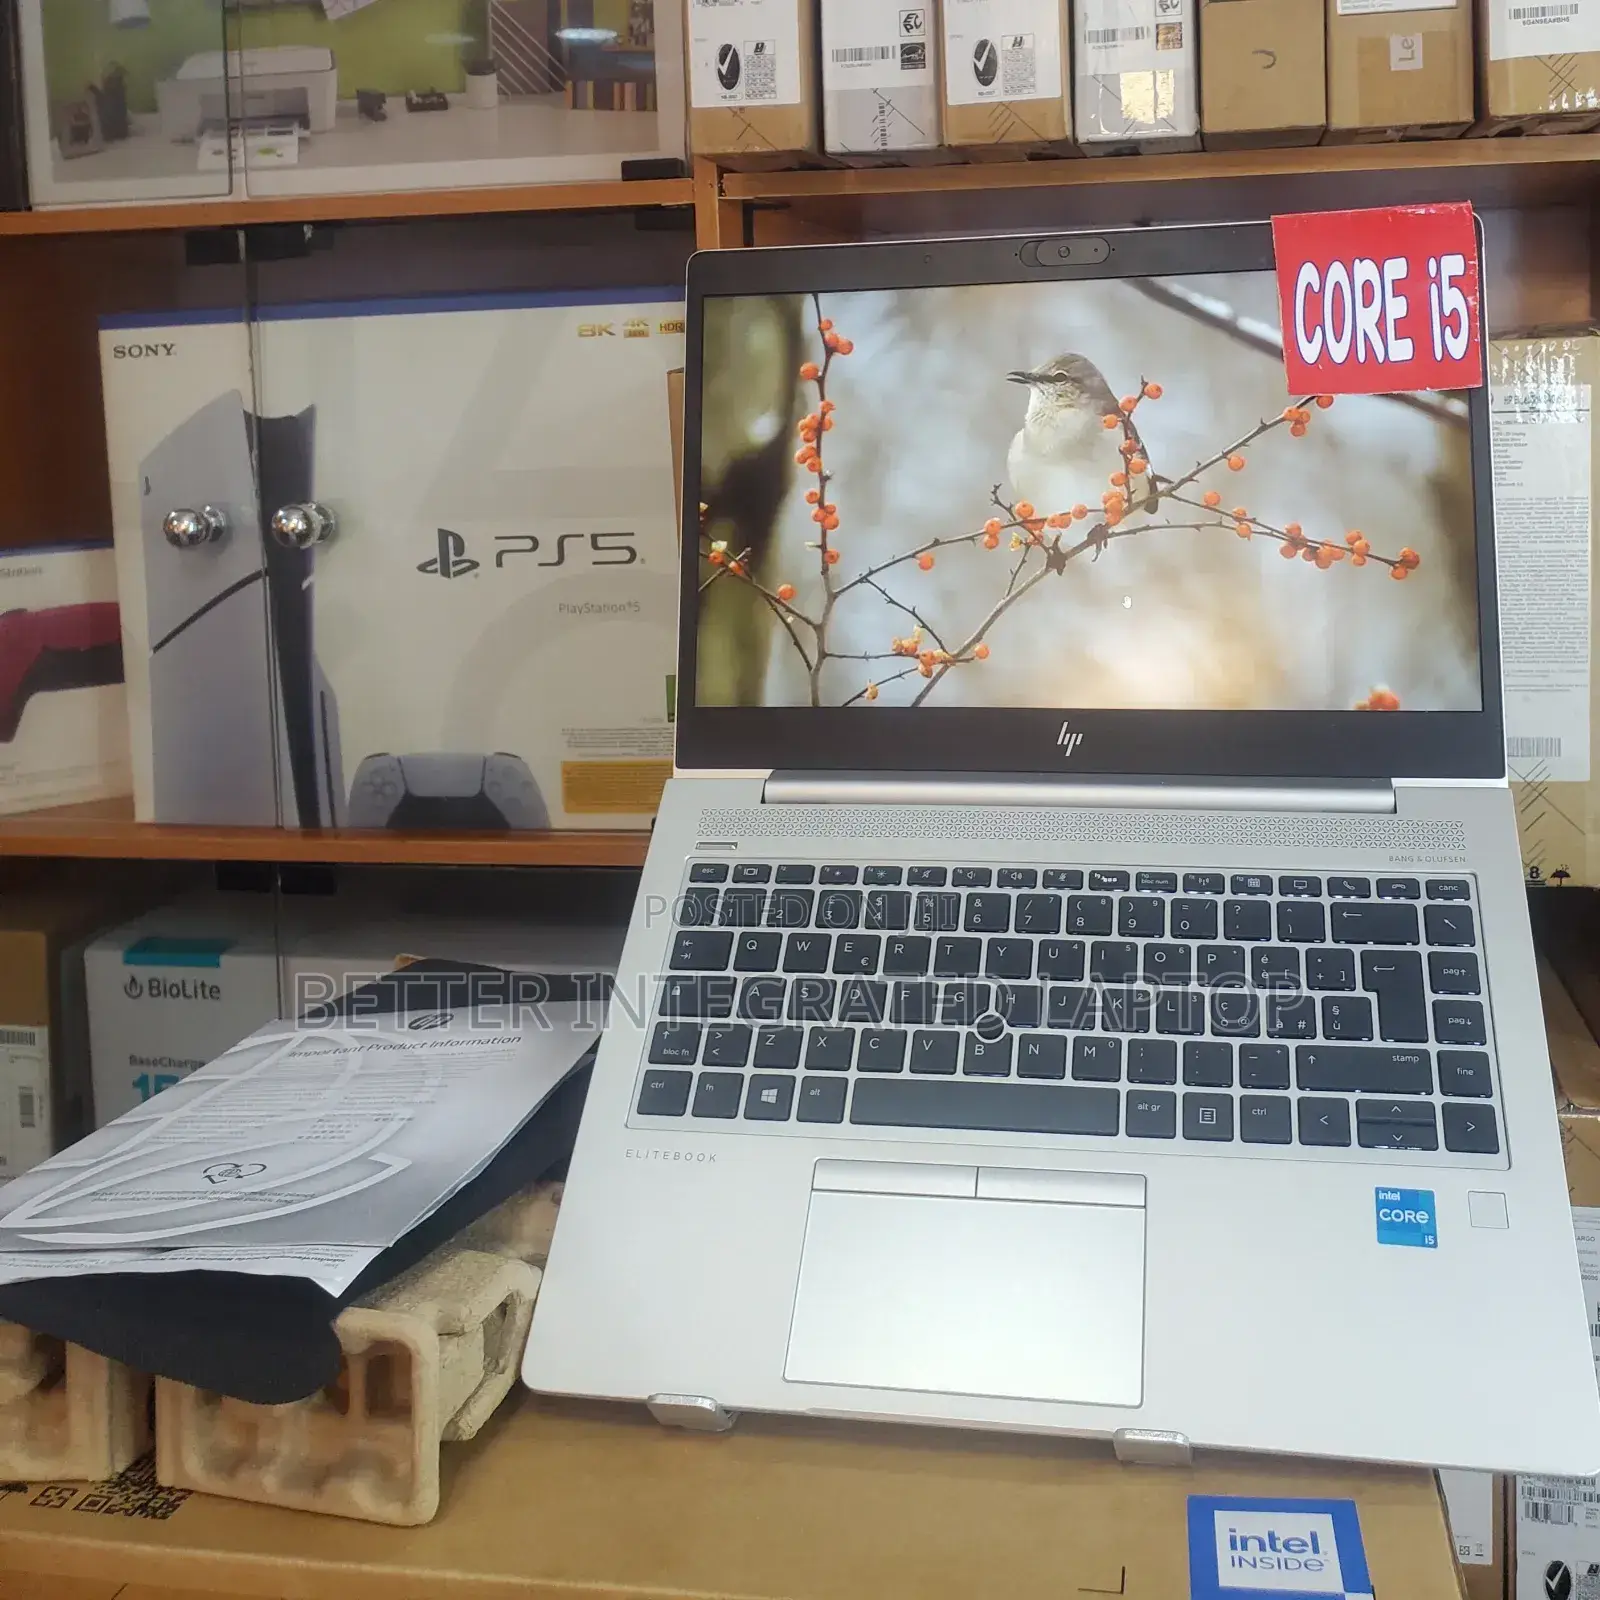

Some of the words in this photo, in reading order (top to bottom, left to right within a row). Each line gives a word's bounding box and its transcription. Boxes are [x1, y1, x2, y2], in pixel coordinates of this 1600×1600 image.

[1294, 257, 1415, 365] CORE
[1428, 254, 1470, 362] i5
[577, 323, 616, 337] 8K
[113, 343, 176, 359] SONY
[494, 532, 638, 568] PS5
[974, 898, 983, 908] &
[776, 910, 784, 919] 2
[1234, 904, 1241, 915] ?
[923, 913, 931, 923] 5
[973, 914, 982, 923] 6
[1024, 916, 1032, 925] 7
[1076, 917, 1085, 927] 8
[1128, 919, 1137, 928] 9
[746, 940, 758, 951] Q
[796, 941, 811, 951] W
[844, 942, 854, 953] E
[894, 944, 904, 954] R
[945, 945, 954, 955] T
[1179, 946, 1184, 954] 6
[997, 946, 1007, 957] Y
[1048, 948, 1059, 959] U
[860, 957, 870, 966] €
[1207, 954, 1217, 964] P
[1443, 967, 1460, 976] pag
[148, 976, 221, 1000] BioLite
[749, 985, 760, 997] A
[800, 987, 809, 998] S
[851, 989, 860, 1000] D
[901, 990, 910, 1000] F
[954, 992, 965, 1002] G
[1005, 994, 1016, 1004] H
[1058, 996, 1067, 1006] J
[1113, 998, 1123, 1009] K
[1167, 1001, 1176, 1011] L
[1297, 1020, 1307, 1030] #
[1448, 1017, 1465, 1026] pag
[765, 1035, 776, 1045] Z
[816, 1036, 828, 1047] X
[869, 1038, 880, 1049] C
[922, 1039, 934, 1050] V
[288, 1045, 366, 1059] Important
[367, 1041, 427, 1053] Product
[429, 1035, 522, 1049] Information
[974, 1044, 985, 1055] B
[1028, 1044, 1040, 1055] N
[1084, 1046, 1096, 1057] M
[663, 1048, 680, 1056] bloc
[681, 1048, 690, 1057] fn
[1392, 1054, 1420, 1064] stamp
[1456, 1067, 1475, 1076] fine
[650, 1081, 665, 1089] ctrl
[705, 1083, 714, 1091] fn
[809, 1088, 821, 1096] alt
[1137, 1102, 1149, 1111] alt
[1150, 1103, 1161, 1112] gr
[1251, 1107, 1267, 1116] ctrl
[625, 1149, 717, 1162] ELITEBOOK
[1378, 1190, 1401, 1201] intel
[1424, 1235, 1435, 1245] i5
[1228, 1528, 1321, 1555] intel
